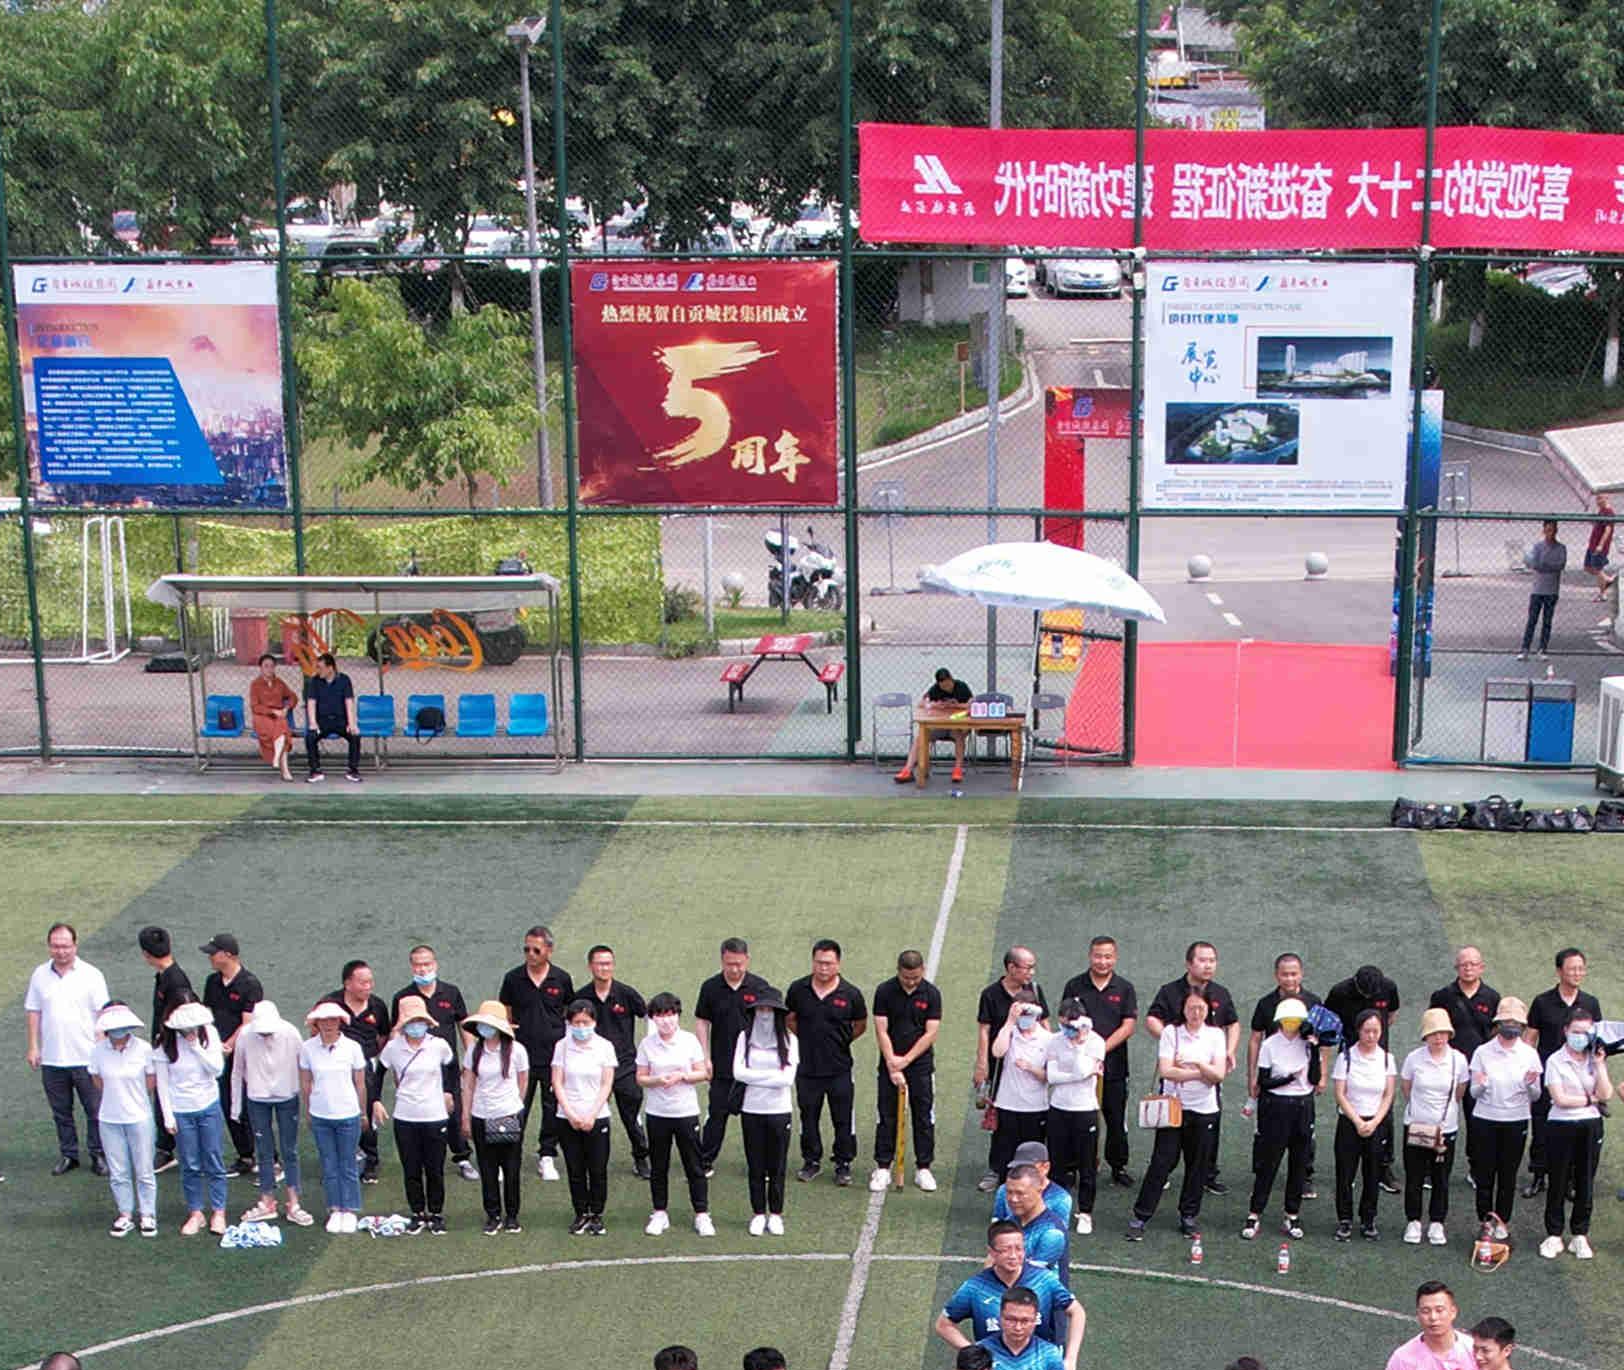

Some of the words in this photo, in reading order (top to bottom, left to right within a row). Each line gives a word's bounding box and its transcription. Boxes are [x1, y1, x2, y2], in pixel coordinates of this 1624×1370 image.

[601, 304, 808, 323] 热烈祝贺自贡城投集团成立
[648, 338, 779, 470] 5
[730, 429, 811, 484] 周年
